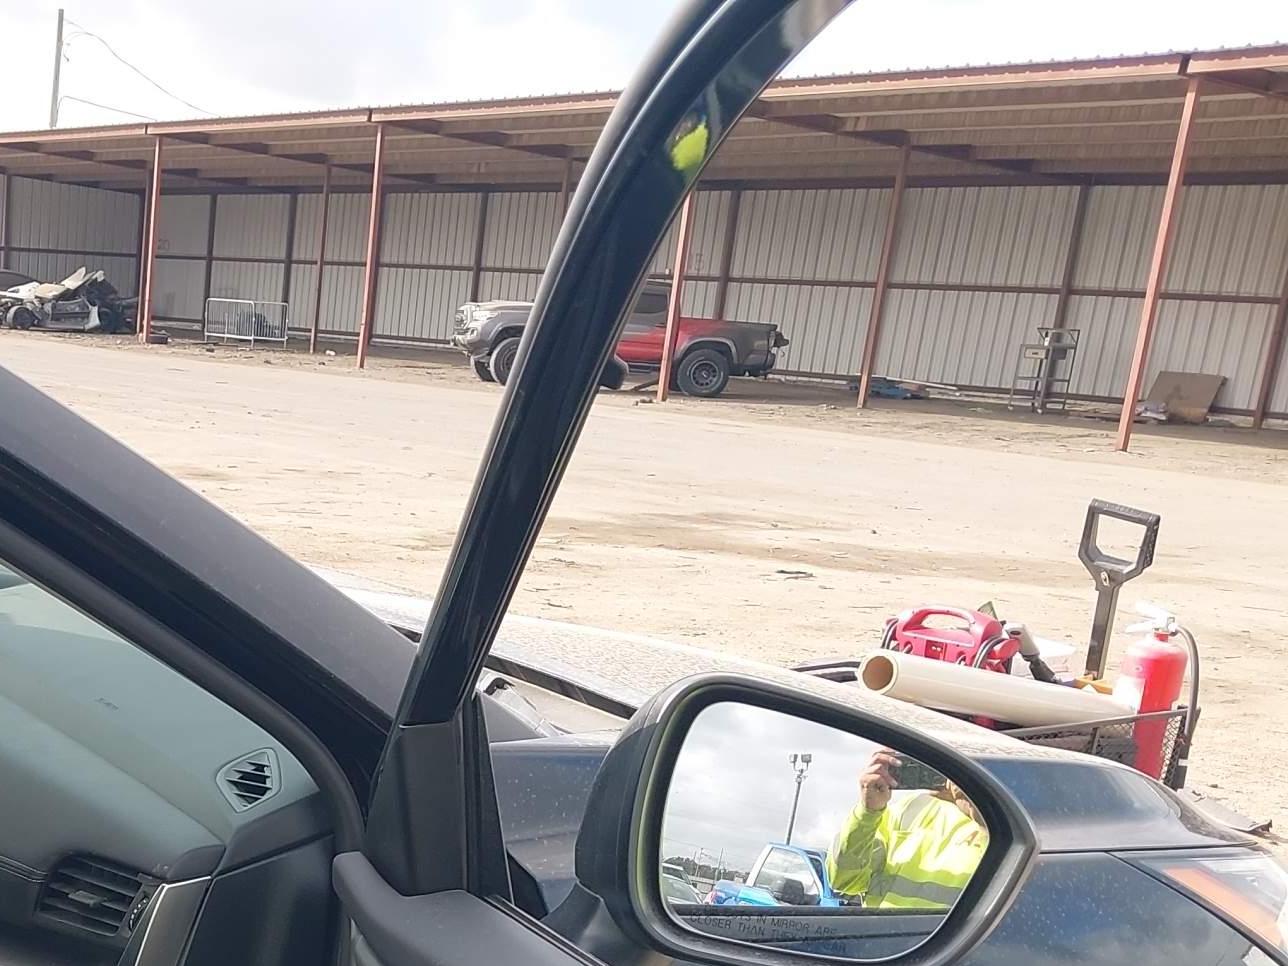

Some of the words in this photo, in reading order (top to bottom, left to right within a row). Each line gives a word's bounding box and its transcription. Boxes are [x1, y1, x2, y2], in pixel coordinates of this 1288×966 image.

[690, 911, 732, 929] CLOSER
[738, 922, 765, 937] THAN
[771, 917, 810, 934] MIRROR
